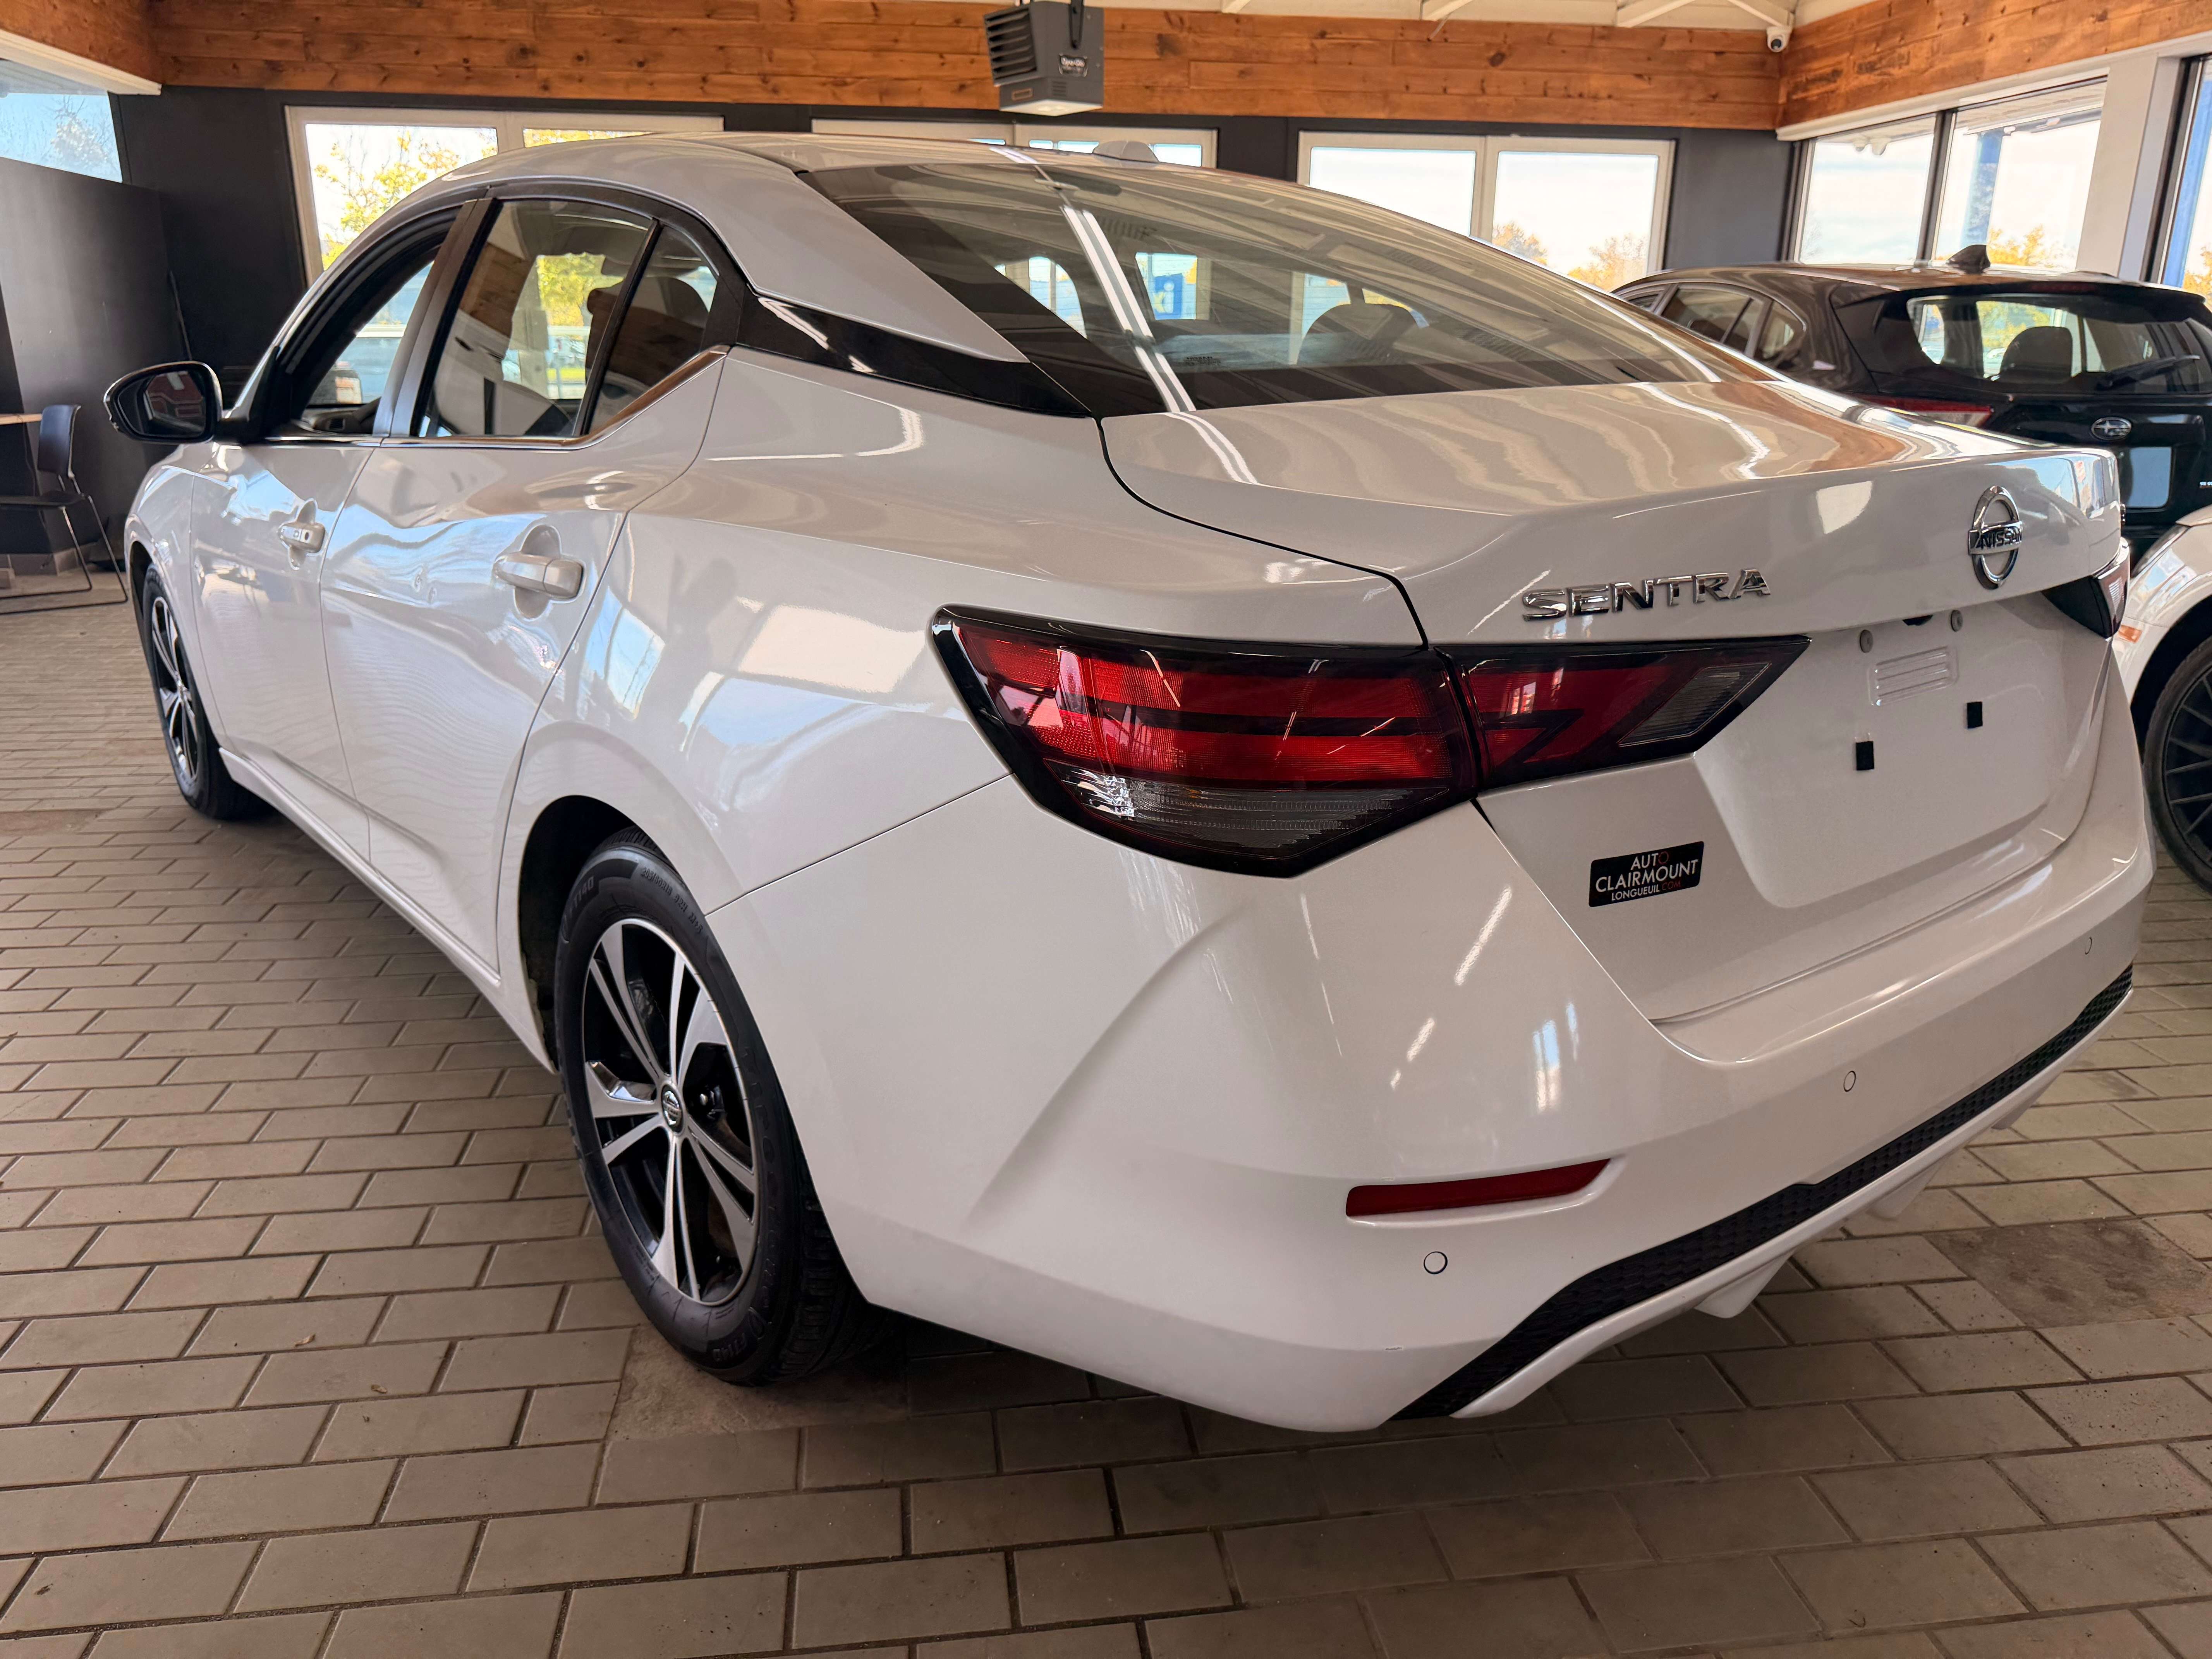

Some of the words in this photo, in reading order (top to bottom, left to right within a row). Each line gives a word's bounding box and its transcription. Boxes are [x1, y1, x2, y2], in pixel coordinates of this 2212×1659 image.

[1976, 526, 2022, 549] NISSAN
[1522, 568, 1771, 621] SENTRA
[1630, 851, 1669, 870] AUTO
[1595, 859, 1698, 892] CLAIRMOUNT
[1611, 884, 1660, 901] LONGUEUIL
